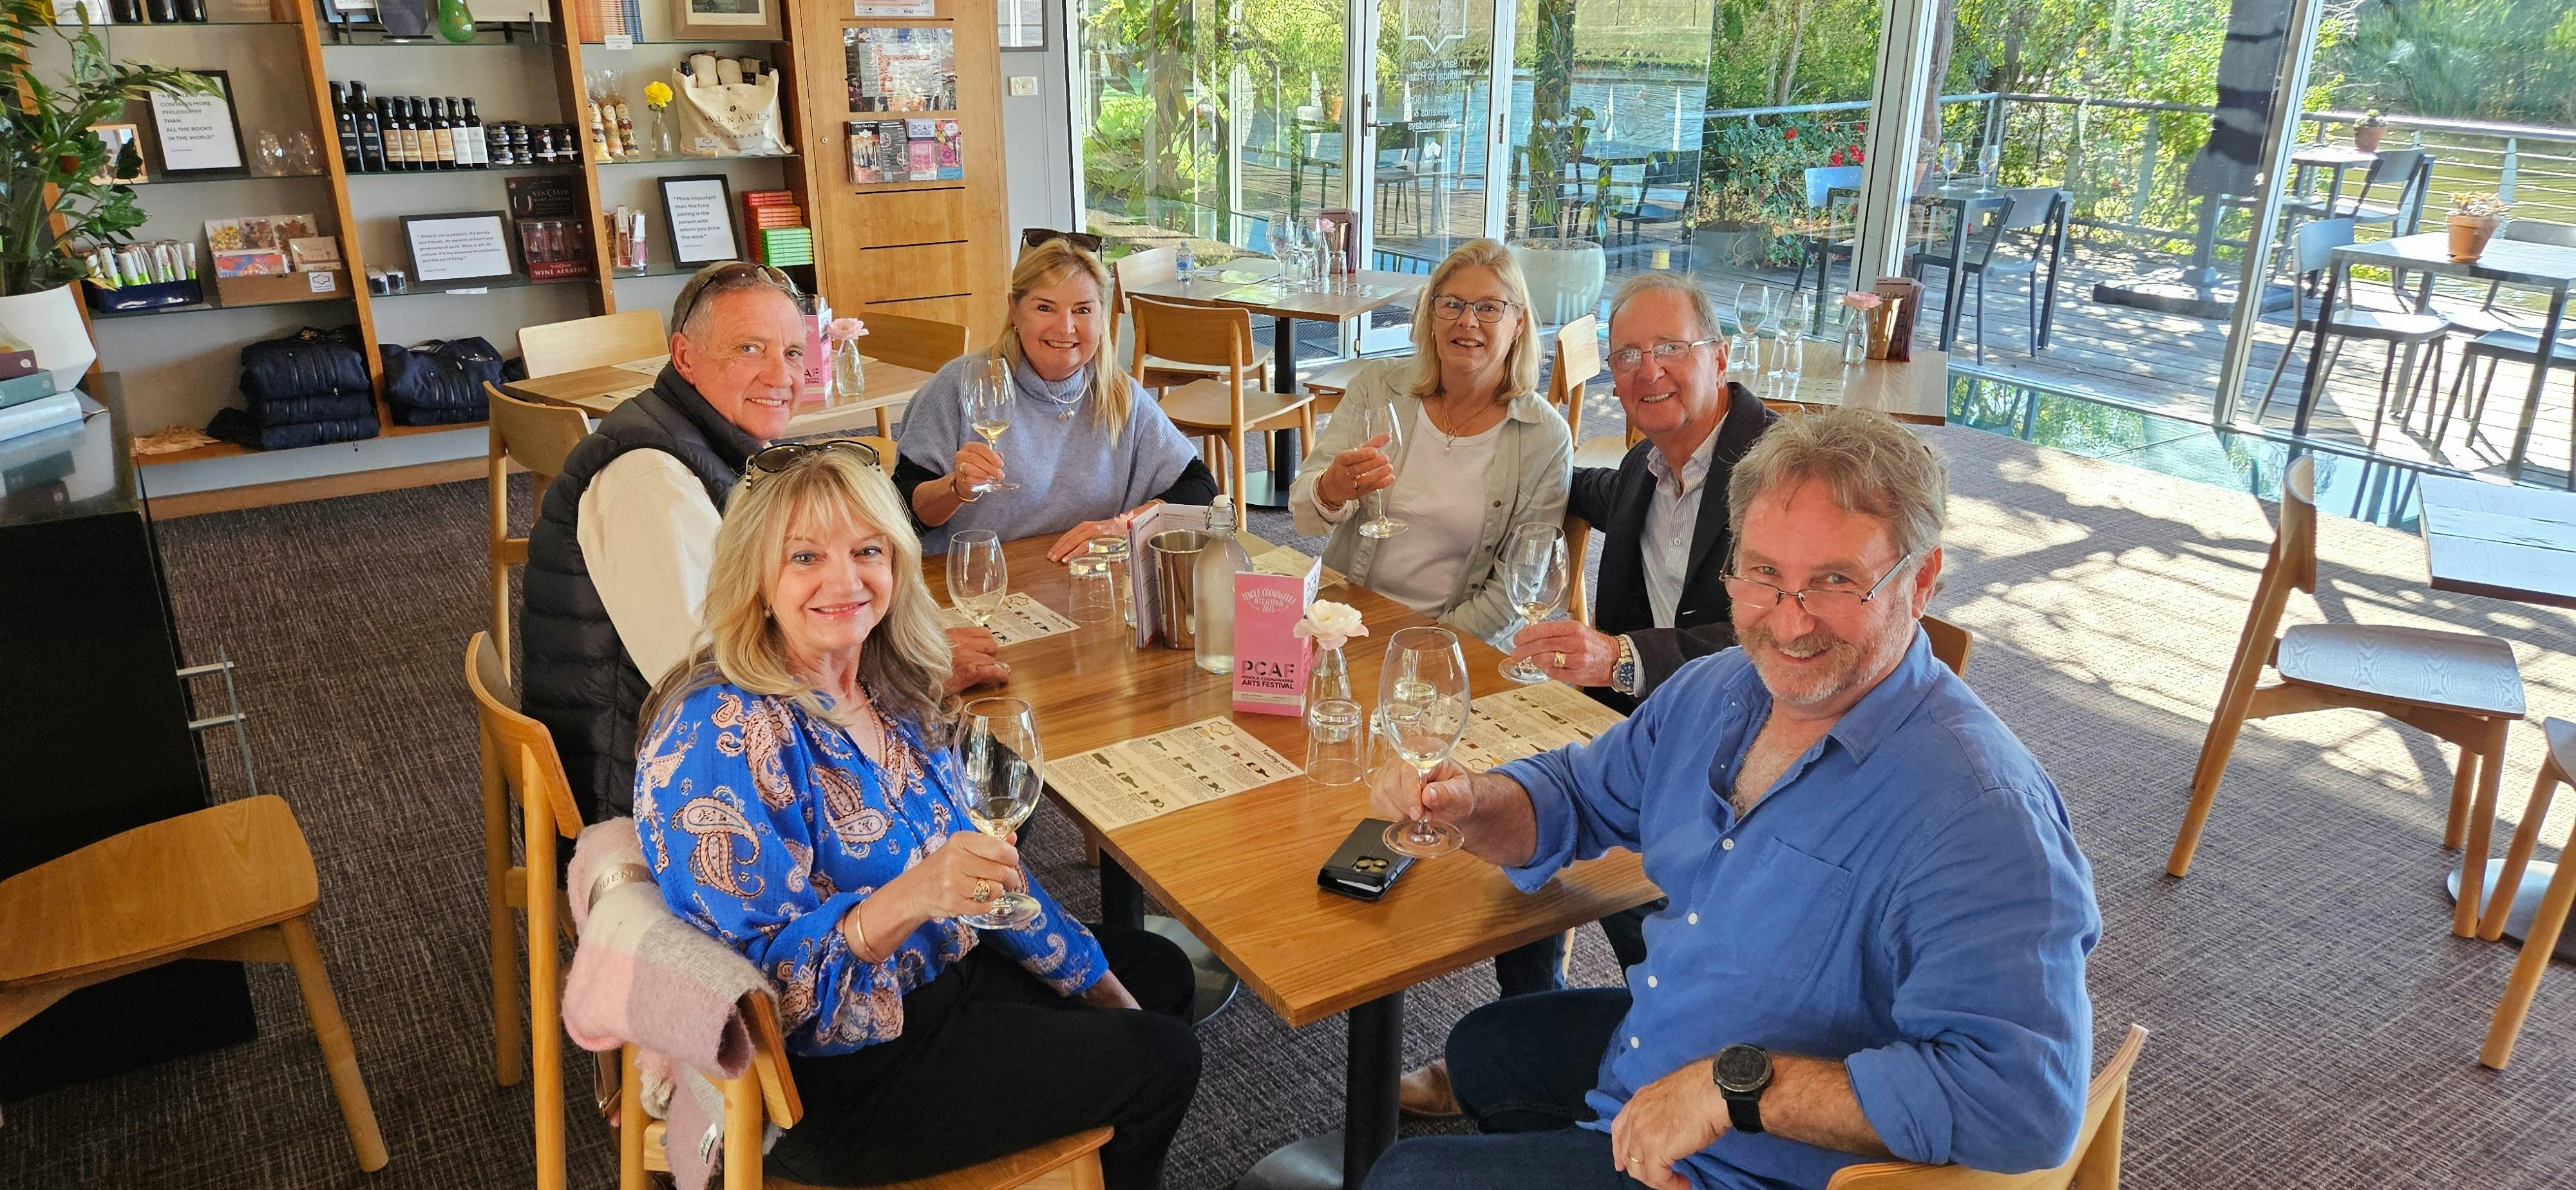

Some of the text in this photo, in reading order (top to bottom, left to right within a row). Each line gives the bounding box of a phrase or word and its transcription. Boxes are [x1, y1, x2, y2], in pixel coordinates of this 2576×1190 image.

[705, 113, 771, 122] ALNAVES
[707, 130, 765, 139] COONAWARR
[804, 368, 819, 377] AF
[1242, 588, 1297, 604] PENOLA COONAWARRA
[1242, 660, 1294, 678] PCAF
[1262, 681, 1294, 689] FESTIVAL
[1262, 750, 1294, 773] Tasting notes
